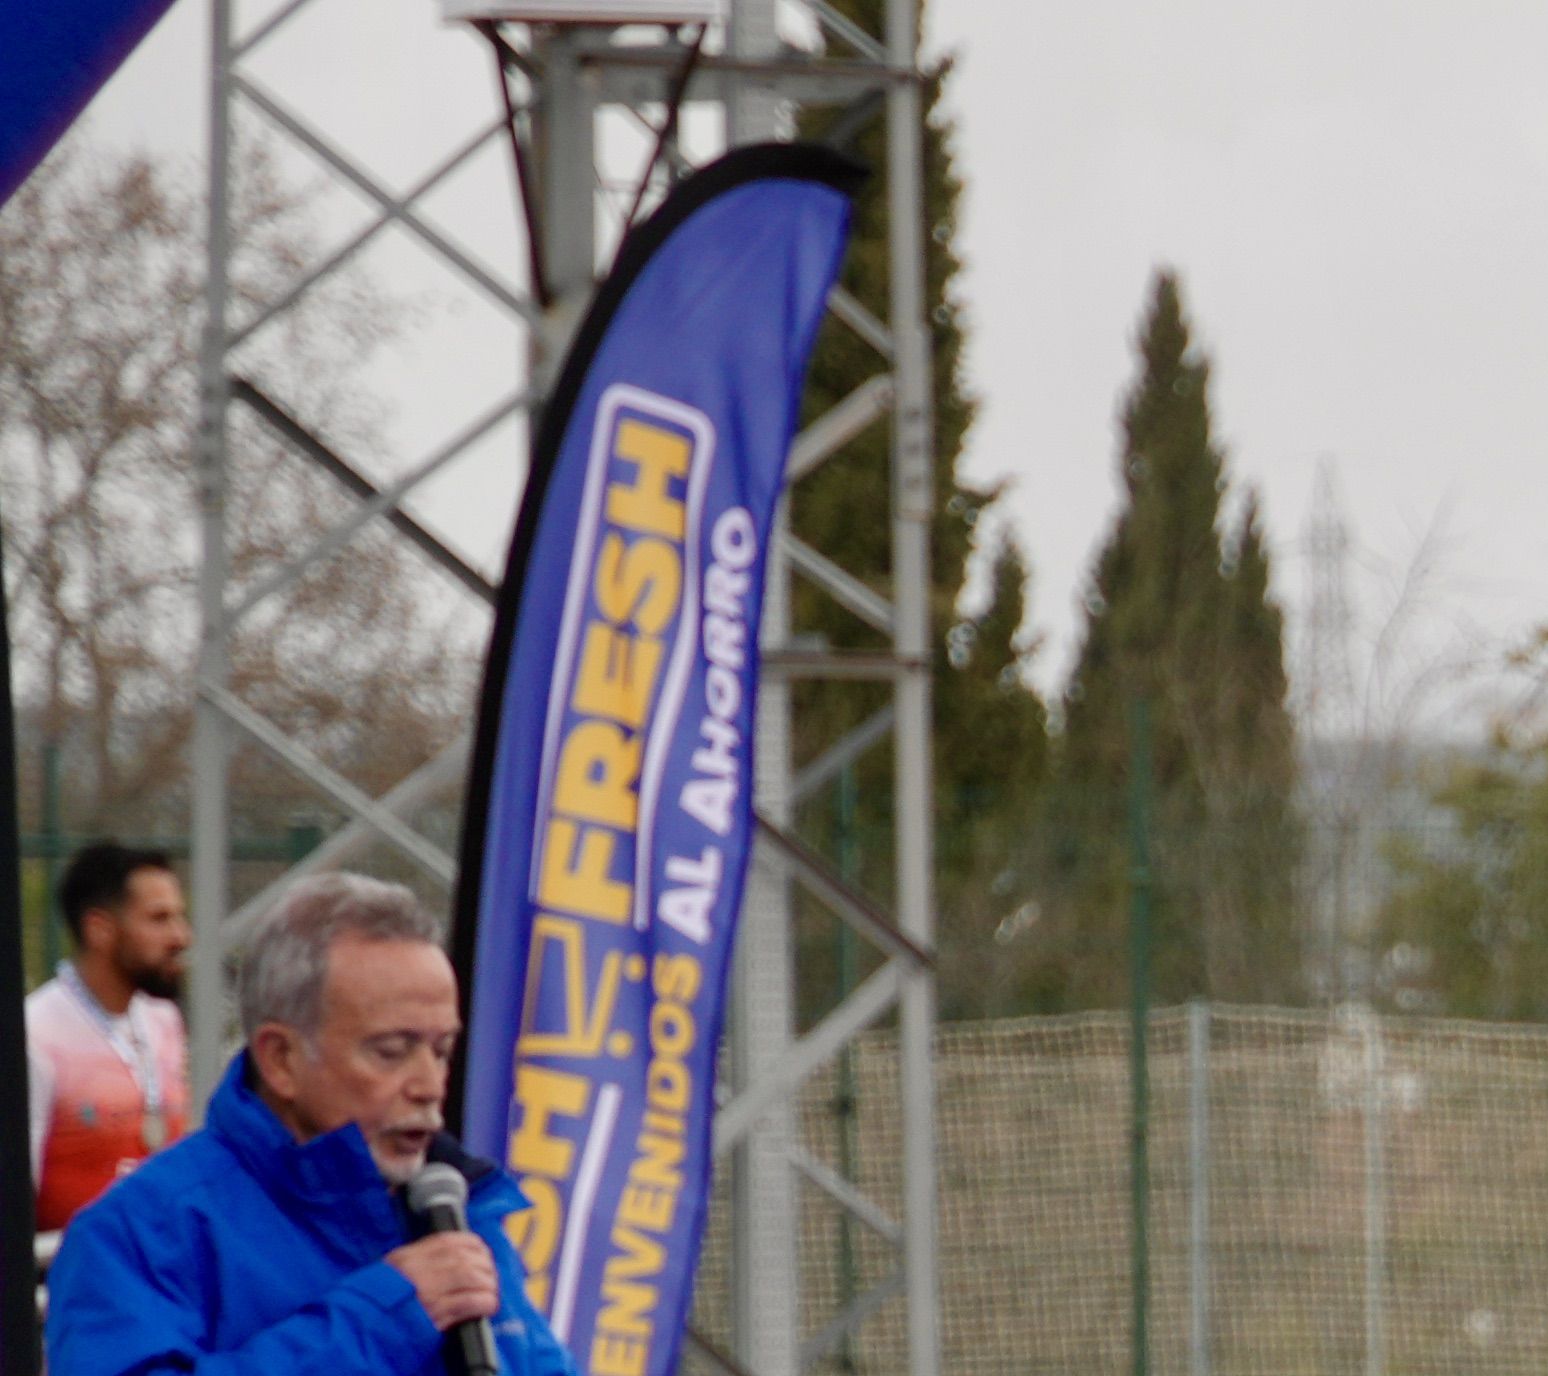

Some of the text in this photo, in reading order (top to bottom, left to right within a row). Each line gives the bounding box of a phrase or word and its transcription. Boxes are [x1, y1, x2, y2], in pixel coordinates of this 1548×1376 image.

[680, 506, 757, 835] AHORRO
[503, 419, 693, 1311] SH FRESH
[657, 846, 723, 944] AL
